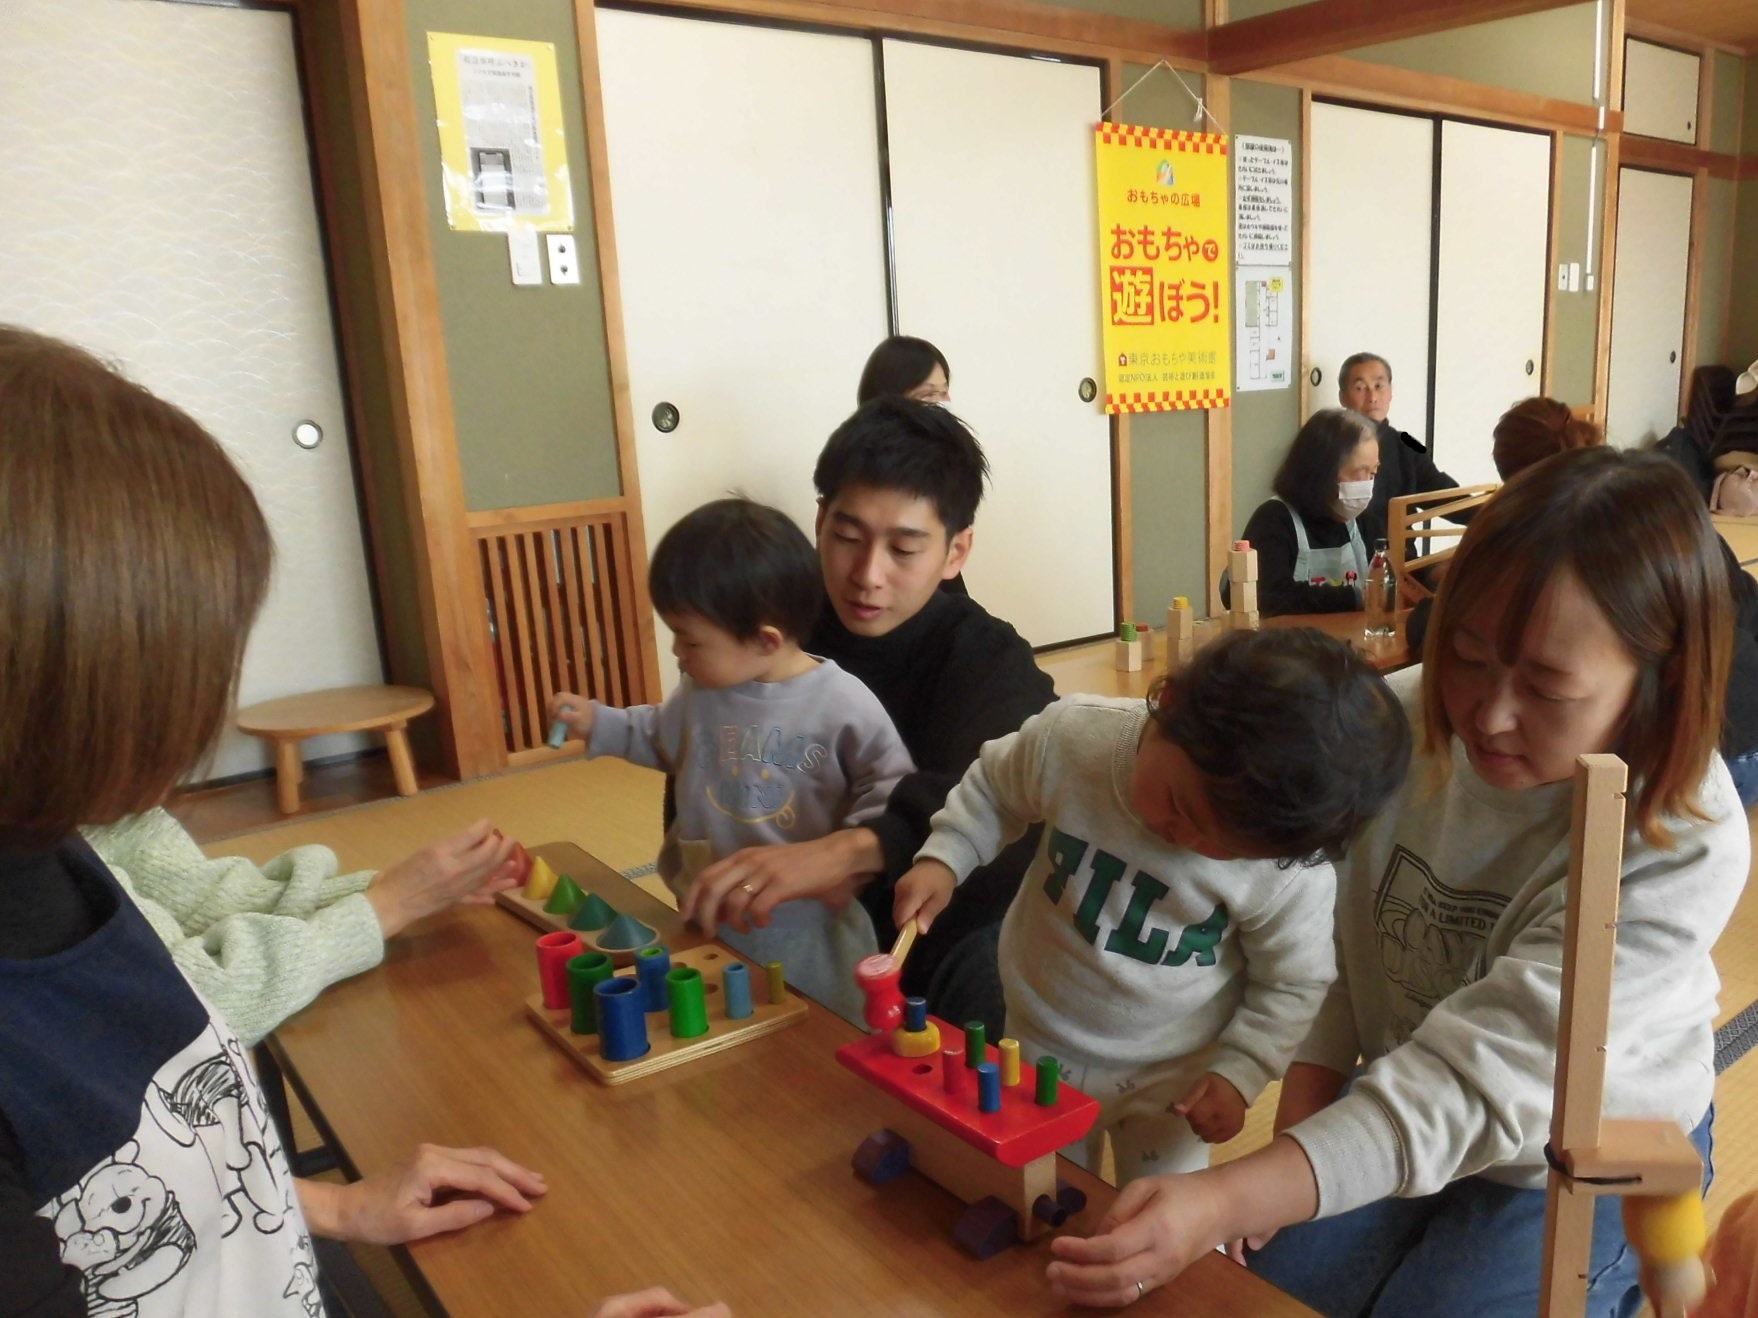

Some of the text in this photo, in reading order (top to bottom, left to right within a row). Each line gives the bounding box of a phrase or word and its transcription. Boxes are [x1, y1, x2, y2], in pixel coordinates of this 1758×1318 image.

[1127, 189, 1201, 208] おもちゃの広場
[1110, 223, 1219, 263] おもちゃで
[1128, 351, 1217, 366] 東京おもちゃ美術館
[1439, 912, 1486, 931] LIMITED
